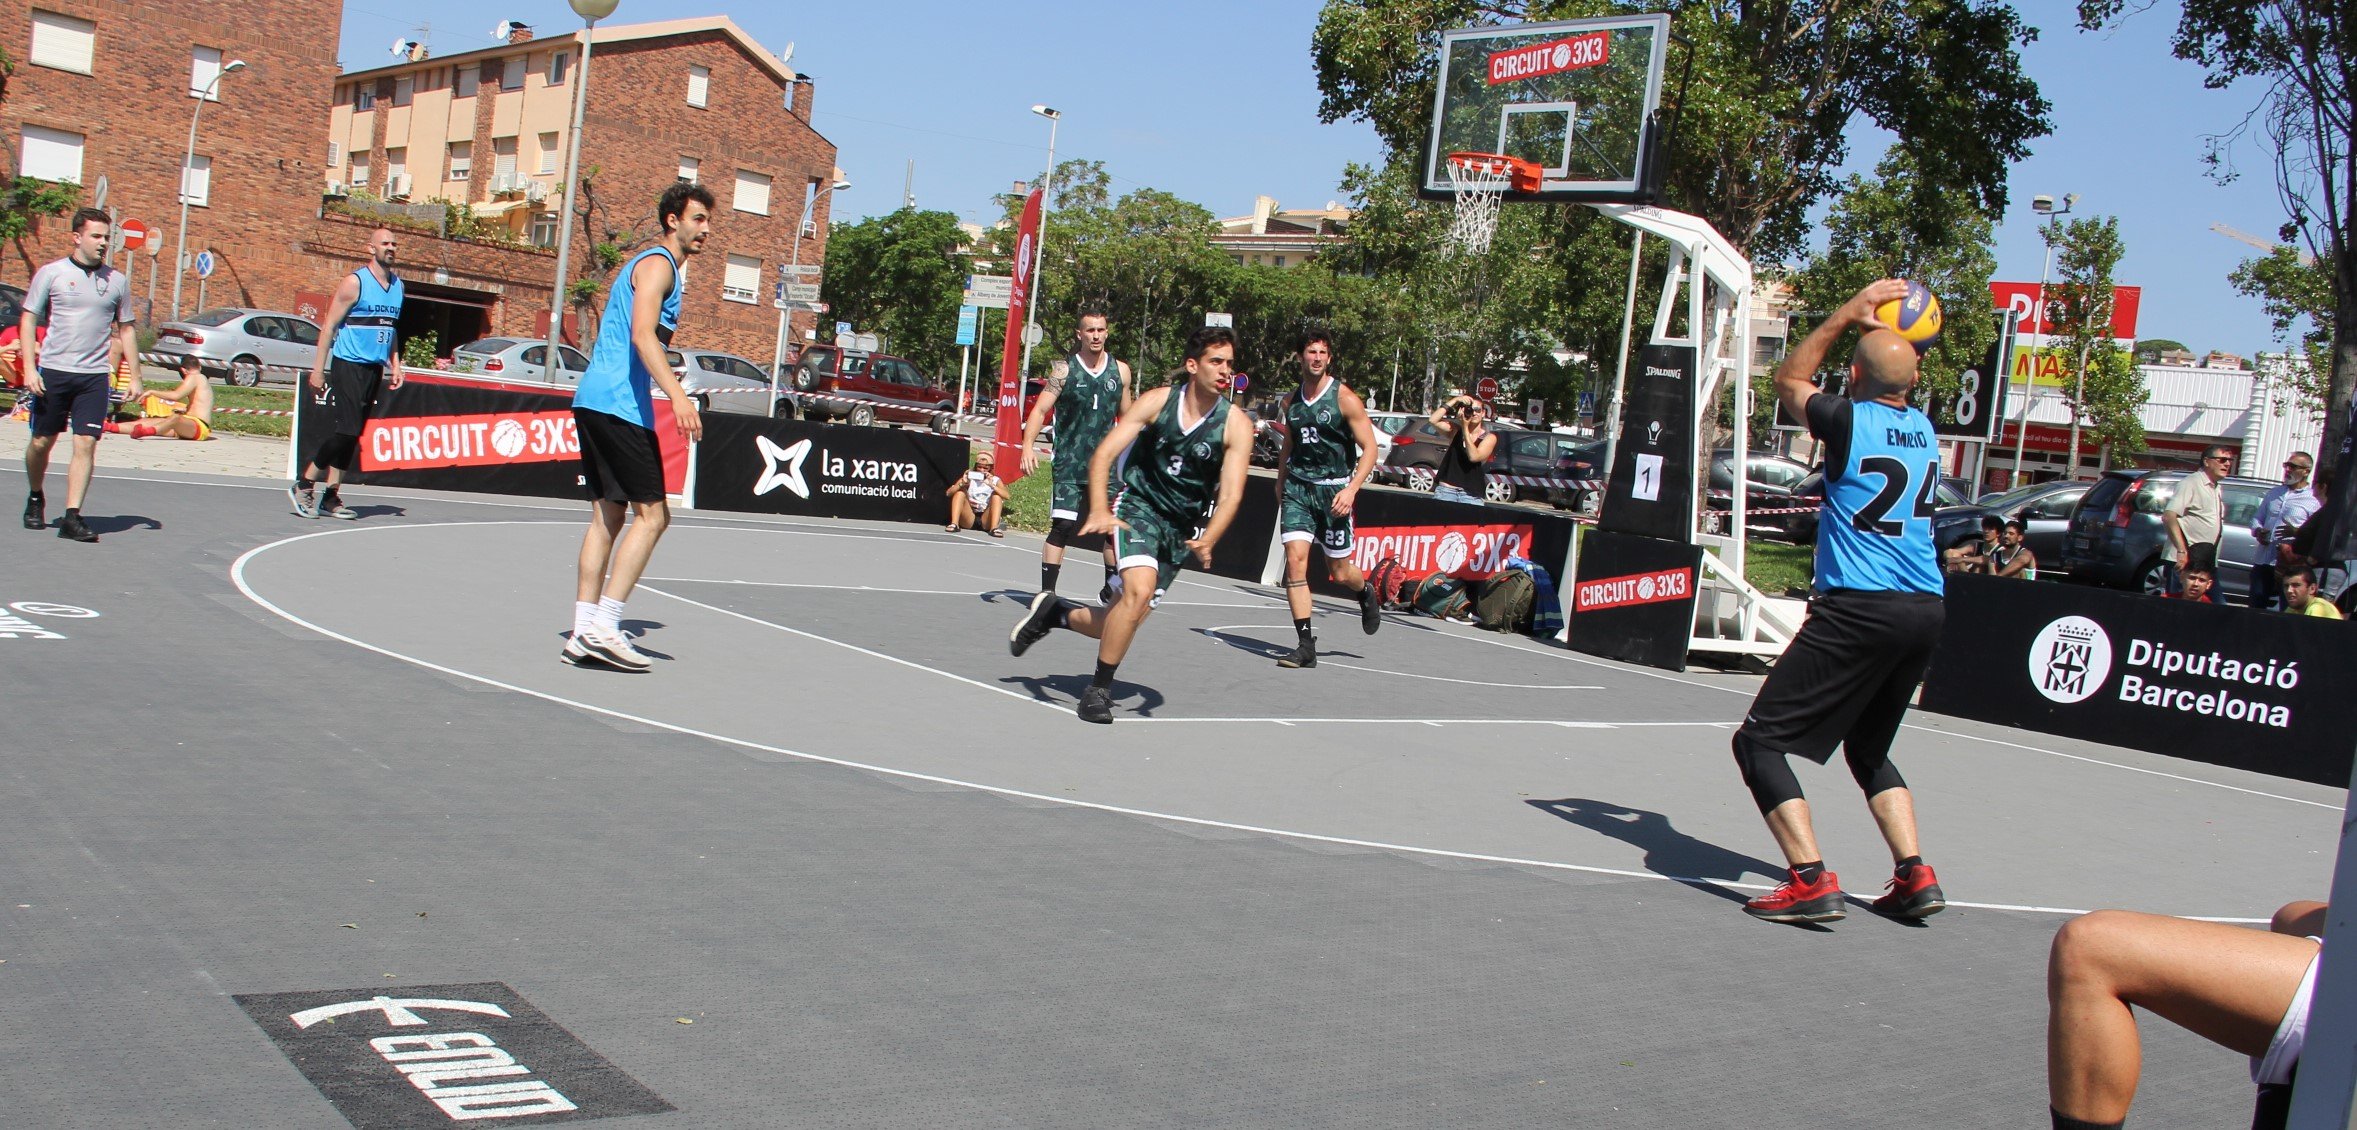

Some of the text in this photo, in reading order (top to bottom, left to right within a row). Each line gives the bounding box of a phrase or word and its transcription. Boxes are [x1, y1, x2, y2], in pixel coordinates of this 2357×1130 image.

[1493, 38, 1602, 80] CIRCUIT 3X3
[1633, 204, 1662, 219] SPALDING
[1646, 366, 1681, 379] SPALDING
[1092, 393, 1099, 410] 1
[1956, 369, 1979, 425] 8
[373, 418, 581, 462] CIRCUIT 3X3
[1300, 427, 1319, 444] 23
[822, 449, 918, 483] la xarxa
[1167, 455, 1183, 476] 3
[1641, 467, 1651, 493] 1
[821, 484, 917, 499] comunicació local
[1851, 455, 1938, 538] 24
[1325, 529, 1345, 546] 23
[1349, 535, 1435, 573] IRCUIT
[1581, 572, 1686, 607] CIRCUIT 3X3
[2126, 638, 2298, 690] Diputació
[2119, 674, 2290, 728] Barcelona
